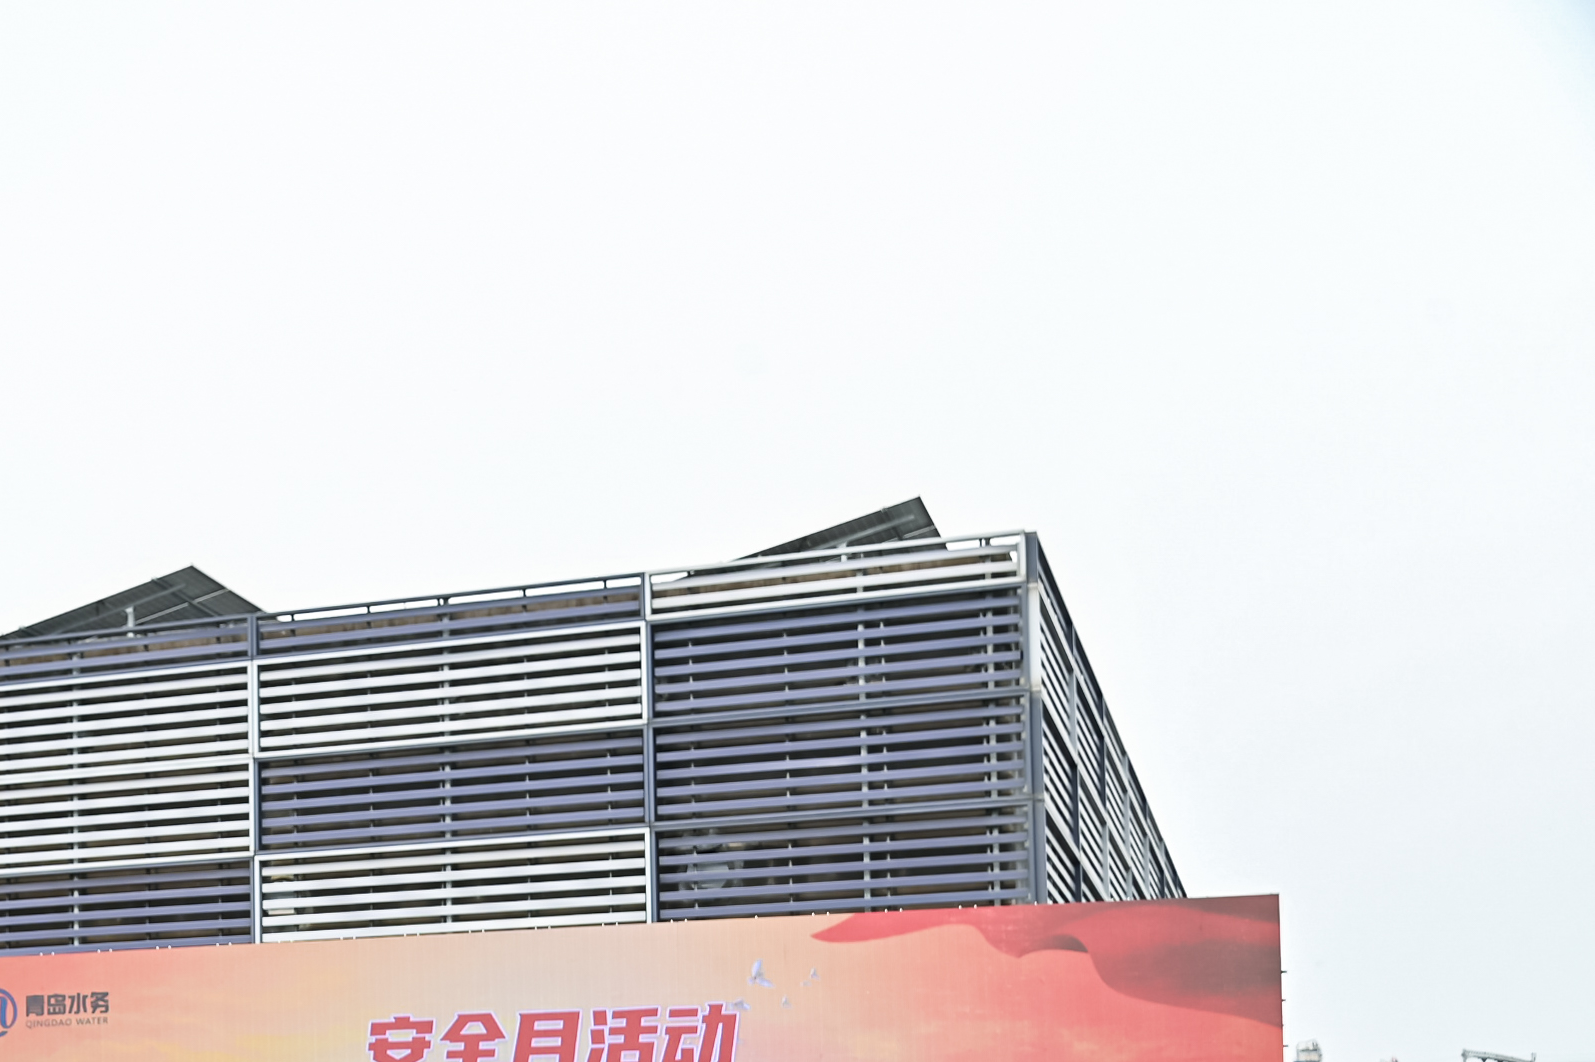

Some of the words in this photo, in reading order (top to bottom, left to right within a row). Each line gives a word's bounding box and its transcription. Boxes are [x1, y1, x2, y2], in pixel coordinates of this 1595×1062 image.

[25, 991, 109, 1017] 青岛水务
[26, 1018, 72, 1029] QINGDAO
[76, 1016, 108, 1026] WATER
